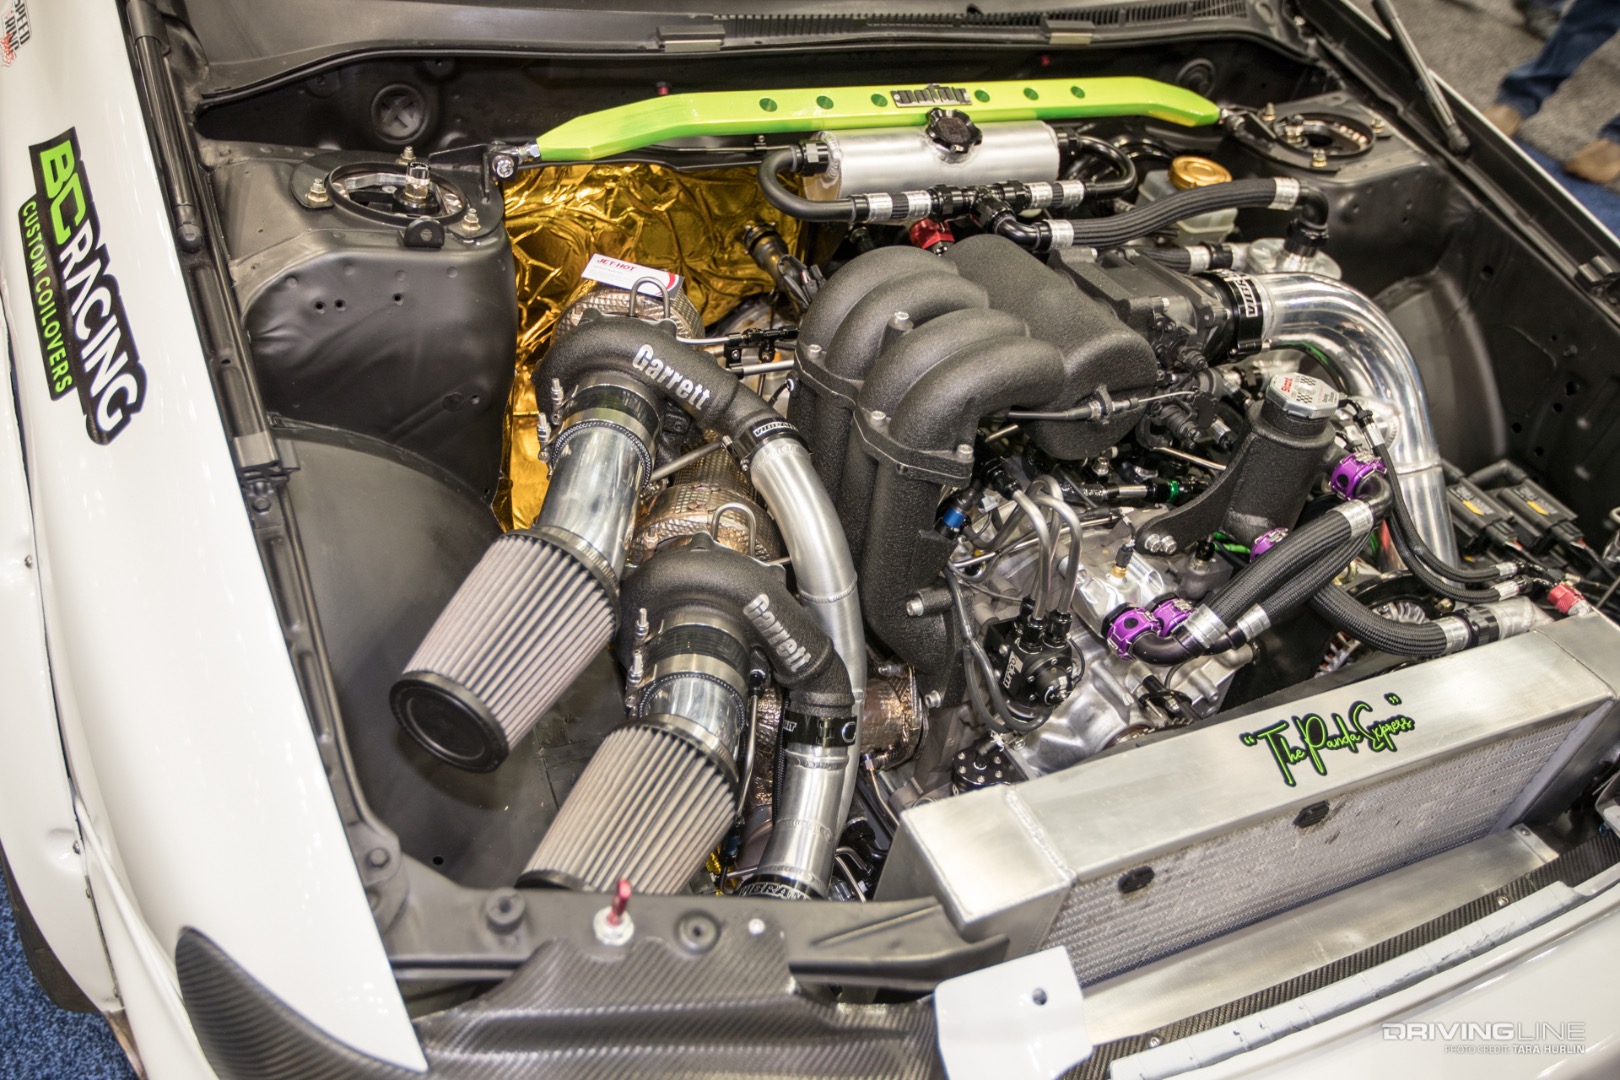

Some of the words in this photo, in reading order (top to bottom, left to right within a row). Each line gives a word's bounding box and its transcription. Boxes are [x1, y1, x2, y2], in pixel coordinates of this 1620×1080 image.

[40, 140, 86, 246] BC
[22, 200, 47, 277] CUSTOM
[35, 276, 73, 393] COILOVERS
[597, 258, 636, 272] JET-HOT
[59, 219, 138, 432] RACING
[632, 343, 711, 411] Garrett
[742, 593, 812, 673] Garrett
[1291, 712, 1361, 776] Panda
